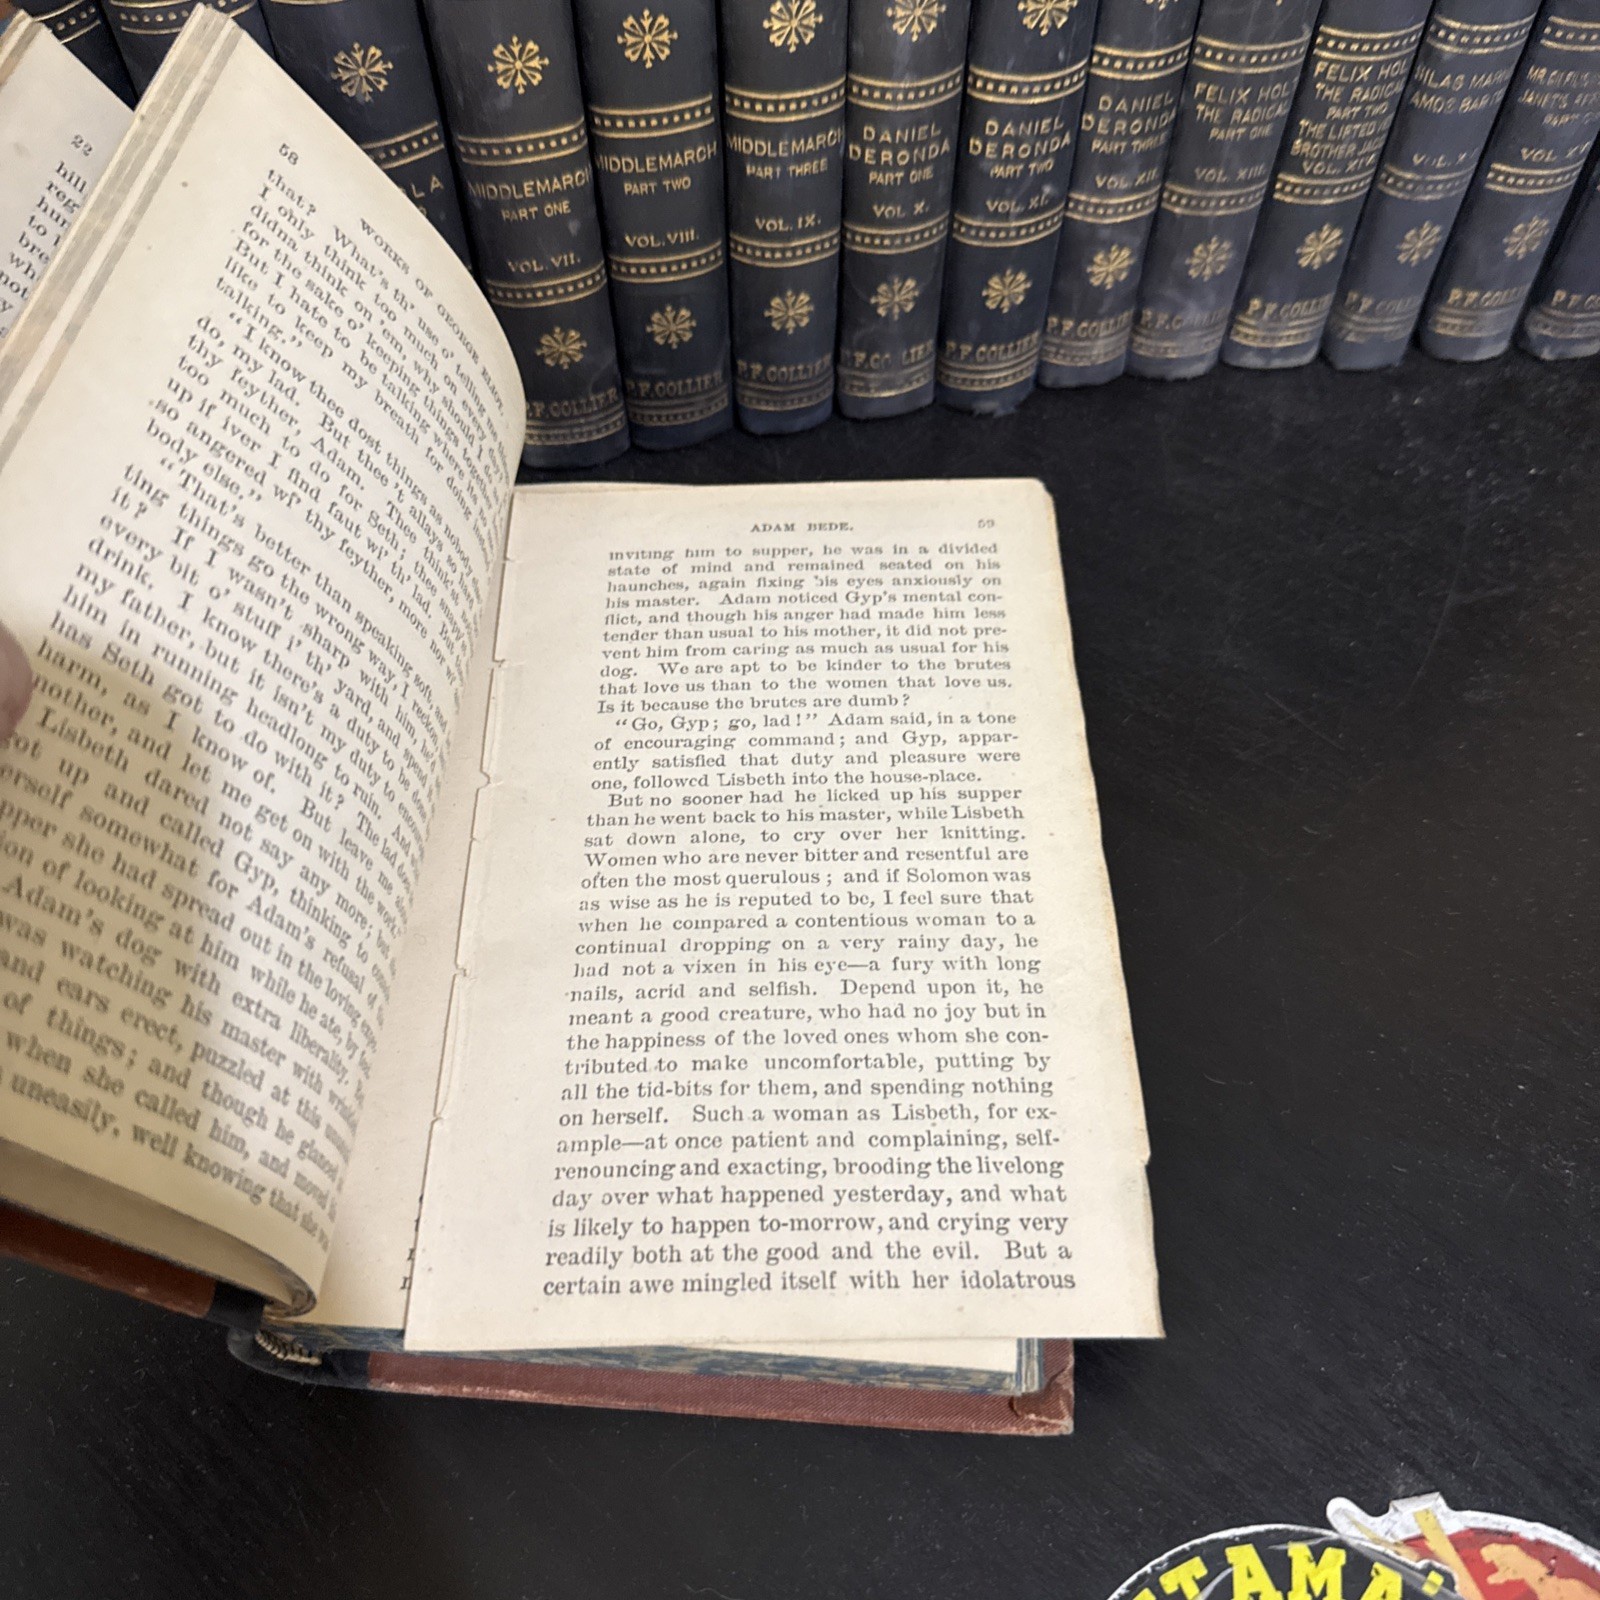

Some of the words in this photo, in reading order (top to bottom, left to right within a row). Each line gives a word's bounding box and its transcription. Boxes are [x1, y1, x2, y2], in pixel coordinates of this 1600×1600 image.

[1313, 61, 1373, 83] FELIX
[1098, 90, 1174, 114] DANIEL
[1193, 82, 1252, 105] FELIX
[1315, 82, 1345, 102] THE
[1081, 105, 1178, 137] DERONDA
[1196, 102, 1222, 123] THE
[1325, 105, 1362, 121] PART
[1364, 101, 1390, 119] TWO
[863, 121, 942, 144] DANIEL
[985, 115, 1065, 138] DANIEL
[1209, 126, 1247, 142] PART
[1248, 123, 1274, 141] ONE
[1298, 119, 1328, 140] THE
[1327, 121, 1377, 141] LIFTED
[71, 133, 94, 157] 22
[725, 126, 845, 158] MIDDLEMARCH
[848, 136, 952, 167] DERONDA
[969, 131, 1072, 160] DERONDA
[1090, 138, 1128, 154] PART
[1290, 139, 1357, 160] BROTHER
[277, 142, 300, 166] 58
[594, 141, 718, 174] MIDDLEMARCH
[745, 163, 782, 180] PART
[788, 157, 829, 178] THREE
[868, 170, 905, 187] PART
[909, 164, 935, 185] ONE
[990, 164, 1025, 179] PART
[1028, 158, 1055, 177] TWO
[267, 168, 318, 217] that?
[623, 182, 658, 197] PART
[662, 175, 693, 193] TWO
[502, 207, 539, 223] PART
[544, 200, 572, 218] ONE
[755, 217, 794, 233] VOL.
[624, 233, 667, 249] VOL.
[360, 217, 410, 276] WORKS
[414, 277, 435, 300] OF
[436, 302, 480, 366] GEORGE
[749, 521, 796, 533] ADAM
[806, 521, 855, 533] BEDE.
[600, 665, 637, 679] dog.
[658, 661, 689, 675] We
[694, 665, 723, 674] are
[730, 661, 760, 676] apt
[769, 661, 787, 672] to
[797, 660, 817, 671] be
[826, 659, 882, 671] kinder
[891, 659, 909, 671] to
[918, 658, 946, 670] the
[955, 658, 1011, 670] brutes
[592, 755, 639, 773] ently
[651, 754, 726, 769] satisfied
[740, 753, 779, 767] that
[791, 752, 834, 768] duty
[845, 751, 878, 765] and
[890, 750, 966, 768] pleasure
[978, 752, 1021, 762] were
[37, 705, 130, 774] Lisbeth
[144, 768, 211, 816] dared
[218, 811, 254, 843] not
[258, 836, 295, 870] say
[299, 864, 332, 897] any
[587, 813, 629, 827] than
[634, 812, 656, 826] he
[660, 812, 706, 825] went
[713, 810, 756, 823] back
[761, 810, 780, 823] to
[786, 808, 814, 822] his
[819, 808, 892, 823] master,
[898, 806, 948, 820] while
[951, 805, 1024, 819] Lisbeth
[584, 852, 657, 867] Women
[662, 851, 702, 865] who
[708, 853, 740, 864] are
[745, 852, 799, 863] never
[804, 848, 859, 862] bitter
[863, 846, 899, 861] and
[906, 846, 991, 861] resentful
[998, 850, 1029, 861] are
[575, 938, 666, 955] continual
[680, 937, 771, 955] dropping
[781, 939, 805, 950] on
[817, 939, 829, 950] a
[840, 938, 885, 953] very
[898, 934, 950, 952] rainy
[961, 933, 1004, 952] day,
[1015, 933, 1038, 948] he
[115, 927, 163, 968] dog
[174, 957, 222, 997] with
[231, 990, 282, 1031] extra
[561, 1083, 587, 1101] all
[596, 1083, 629, 1099] the
[637, 1080, 713, 1098] tid-bits
[720, 1079, 750, 1096] for
[758, 1078, 818, 1099] them,
[824, 1078, 862, 1095] and
[870, 1078, 965, 1100] spending
[972, 1076, 1053, 1097] nothing
[555, 1159, 676, 1181] renouncing
[680, 1158, 720, 1177] and
[727, 1157, 827, 1179] exacting,
[833, 1157, 932, 1179] brooding
[936, 1156, 972, 1174] the
[976, 1155, 1065, 1179] livelong
[543, 1275, 621, 1296] certain
[629, 1279, 674, 1294] awe
[682, 1271, 772, 1297] mingled
[782, 1270, 837, 1290] itself
[849, 1269, 900, 1290] with
[912, 1270, 949, 1289] her
[961, 1269, 1076, 1290] idolatrous
